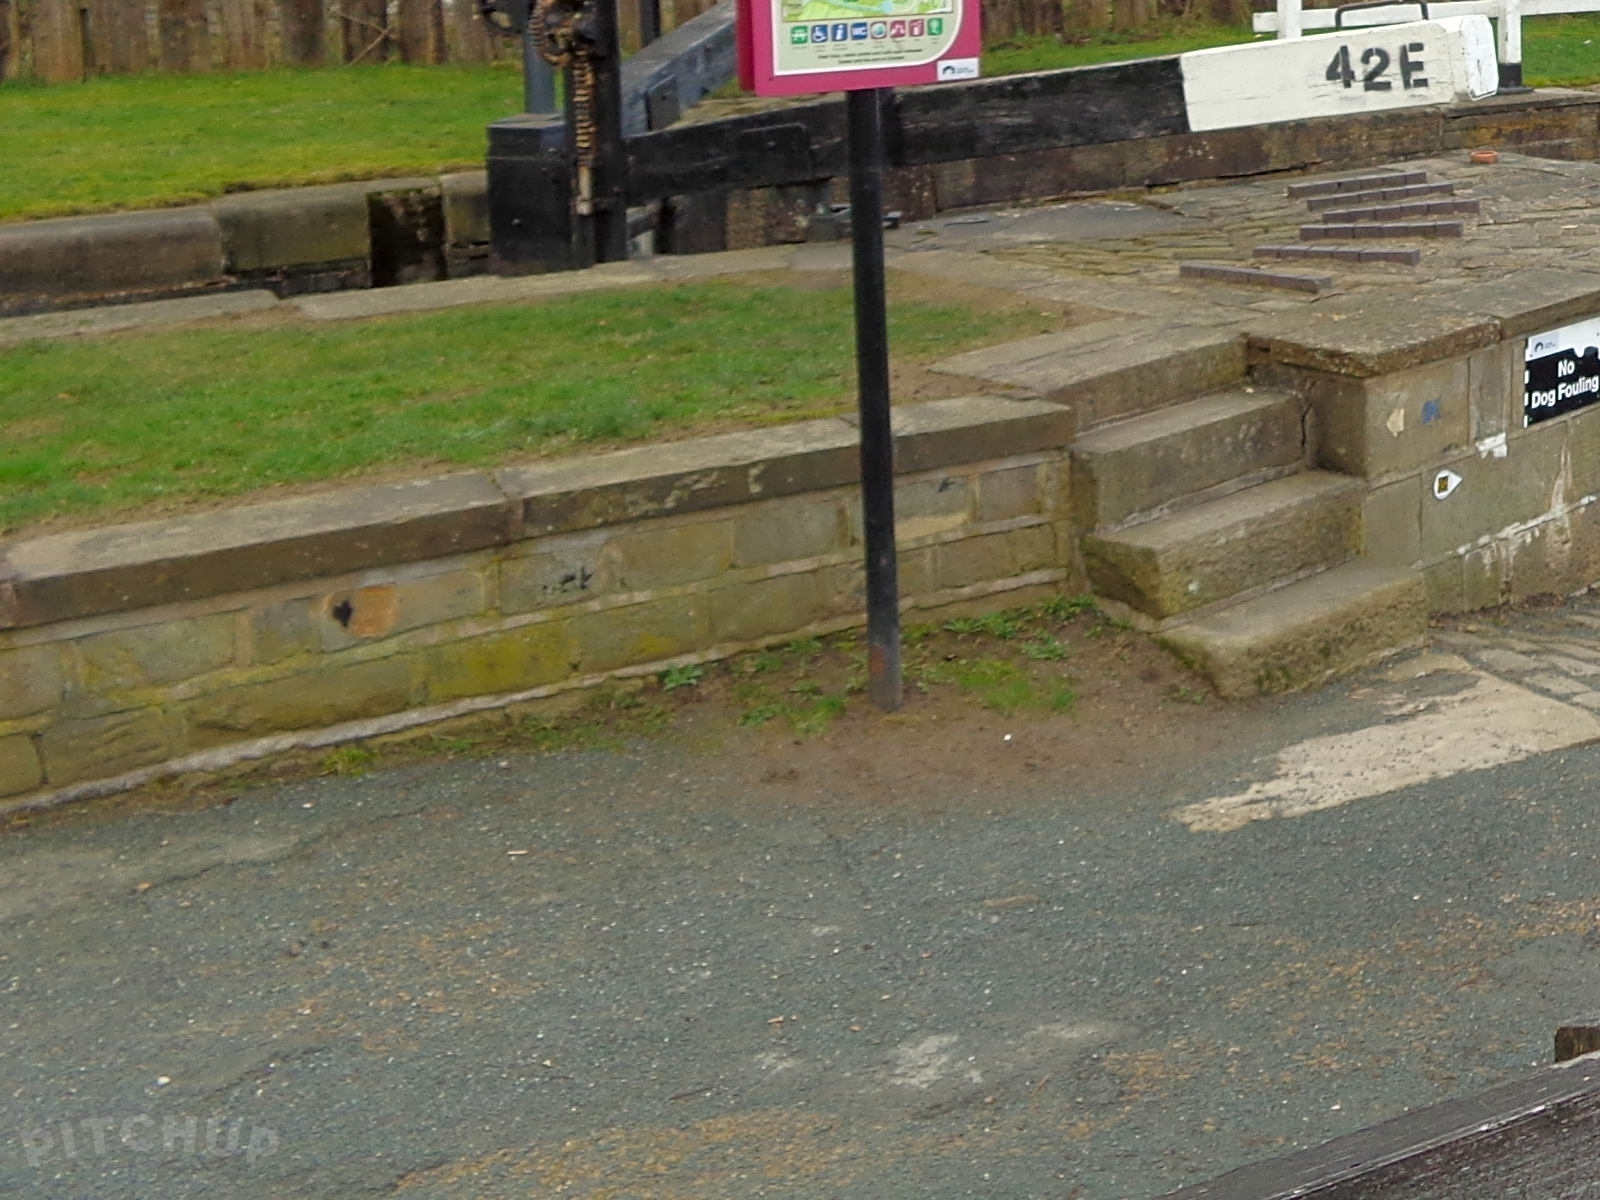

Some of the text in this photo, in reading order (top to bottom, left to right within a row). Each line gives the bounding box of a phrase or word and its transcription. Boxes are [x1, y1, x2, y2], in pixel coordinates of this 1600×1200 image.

[1326, 42, 1429, 92] 42E
[1557, 359, 1575, 377] No
[1531, 375, 1599, 409] Dog Fouling
